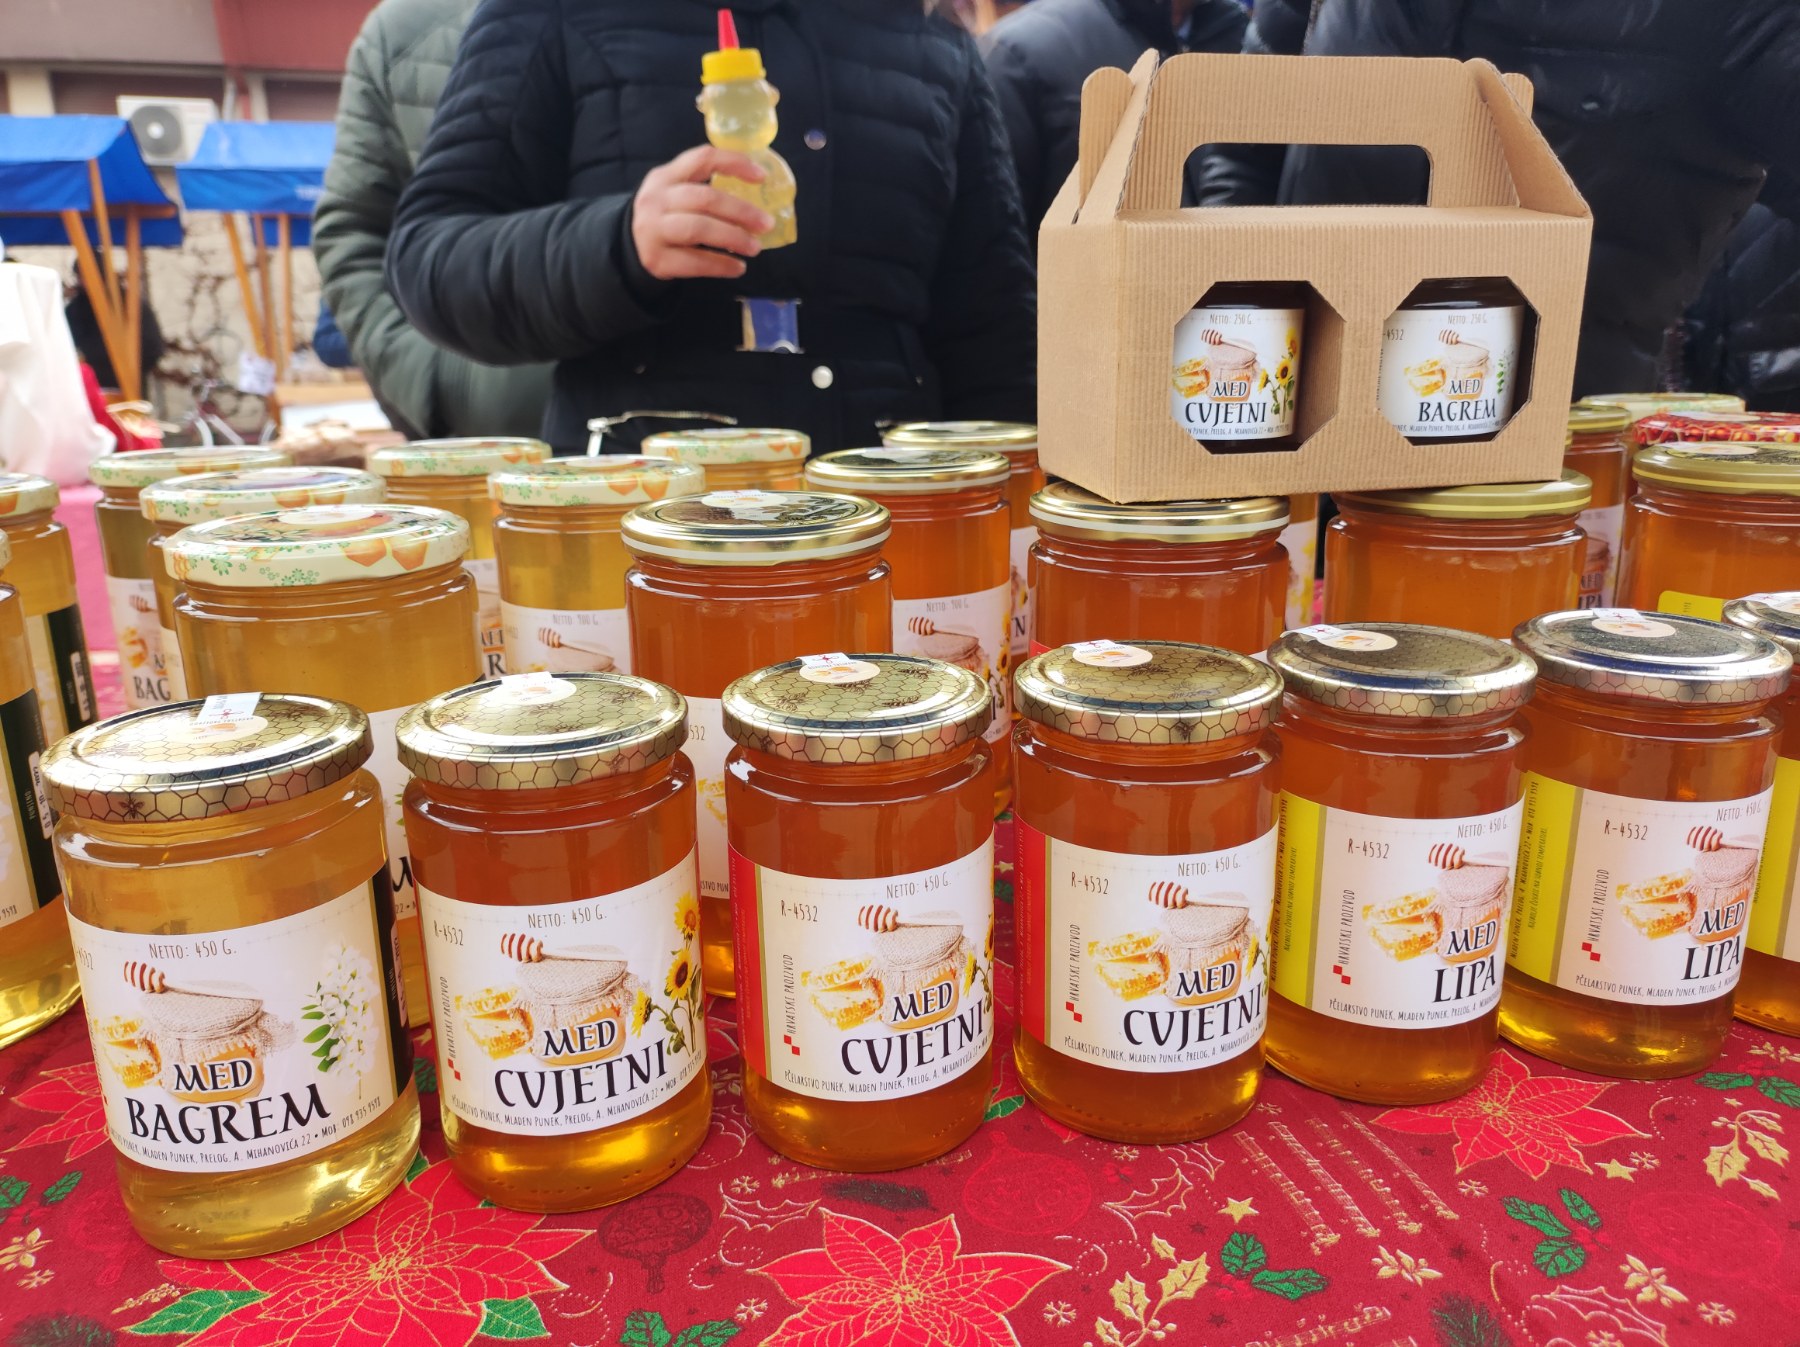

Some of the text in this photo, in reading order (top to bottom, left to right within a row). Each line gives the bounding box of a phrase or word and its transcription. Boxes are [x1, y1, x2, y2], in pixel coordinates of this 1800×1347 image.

[1234, 314, 1246, 324] 250
[1382, 328, 1405, 341] -4532
[1213, 381, 1247, 397] MED
[1450, 379, 1481, 395] MED
[1185, 402, 1267, 427] CVJETNI
[1417, 398, 1497, 422] BAGREM
[133, 675, 171, 702] BAG
[690, 724, 706, 741] 532
[1717, 807, 1742, 821] NETTO:
[1458, 824, 1485, 839] NETTO:
[1489, 818, 1503, 833] 450
[1604, 819, 1648, 841] R-4532
[1347, 838, 1390, 860] R-4532
[1178, 861, 1212, 877] NETTO:
[1215, 856, 1231, 873] 450
[701, 879, 729, 893] STVO PUN
[886, 880, 920, 899] NETTO:
[924, 875, 940, 893] 450
[1071, 871, 1109, 895] R-4532
[2, 904, 18, 918] 9598
[528, 912, 566, 929] NETTO:
[572, 906, 591, 923] 450
[780, 899, 818, 923] R-4532
[1587, 869, 1610, 942] HRVATSKI PROIZVOD
[1698, 901, 1745, 935] MED
[433, 919, 464, 946] R-4532
[1338, 889, 1355, 965] HRVATSKI PROIZVOD
[1447, 919, 1497, 955] MED
[77, 947, 94, 971] -4532
[149, 942, 190, 960] NETTO:
[195, 941, 218, 958] 450
[1069, 924, 1081, 1002] HRVATSKI PROIZVOD
[1681, 935, 1741, 981] LIPA
[1175, 963, 1236, 997] MED
[1432, 955, 1497, 1004] LIPA
[1576, 974, 1616, 993] PČELARSTVO
[1618, 984, 1644, 997] PUNEK,
[1646, 987, 1673, 998] MLADEN
[440, 976, 452, 1018] PROIZVOD
[783, 954, 797, 1035] HRVATSKI PROIZVOD
[891, 981, 953, 1022] MED
[1123, 981, 1262, 1052] CVJETNI
[1329, 998, 1368, 1017] PČELARSTVO
[1370, 1008, 1396, 1021] PUNEK,
[1397, 1011, 1425, 1021] MLADEN
[543, 1019, 616, 1057] MED
[841, 999, 983, 1079] CVJETNI
[1064, 1035, 1100, 1057] PČELARSTVO
[1102, 1048, 1127, 1063] PUNEK,
[1129, 1053, 1157, 1064] MLADEN
[173, 1059, 254, 1092] MED
[494, 1037, 669, 1115] CVJETNI
[784, 1068, 820, 1090] PČELARSTVO
[821, 1080, 847, 1094] PUNEK,
[848, 1081, 877, 1094] MLADEN
[879, 1080, 905, 1092] PUNEK,
[124, 1082, 332, 1146] BAGREM
[505, 1114, 532, 1127] MLADEN
[534, 1116, 563, 1127] PUNEK,
[565, 1112, 594, 1124] PRELOG,
[607, 1091, 649, 1117] MIHANOVIĆA
[142, 1146, 168, 1162] MLADEN
[170, 1153, 198, 1165] PUNEK,
[246, 1138, 299, 1160] MIHANOVIĆA
[301, 1133, 311, 1147] 22
[321, 1123, 340, 1138] MOB:
[342, 1115, 355, 1128] 098
